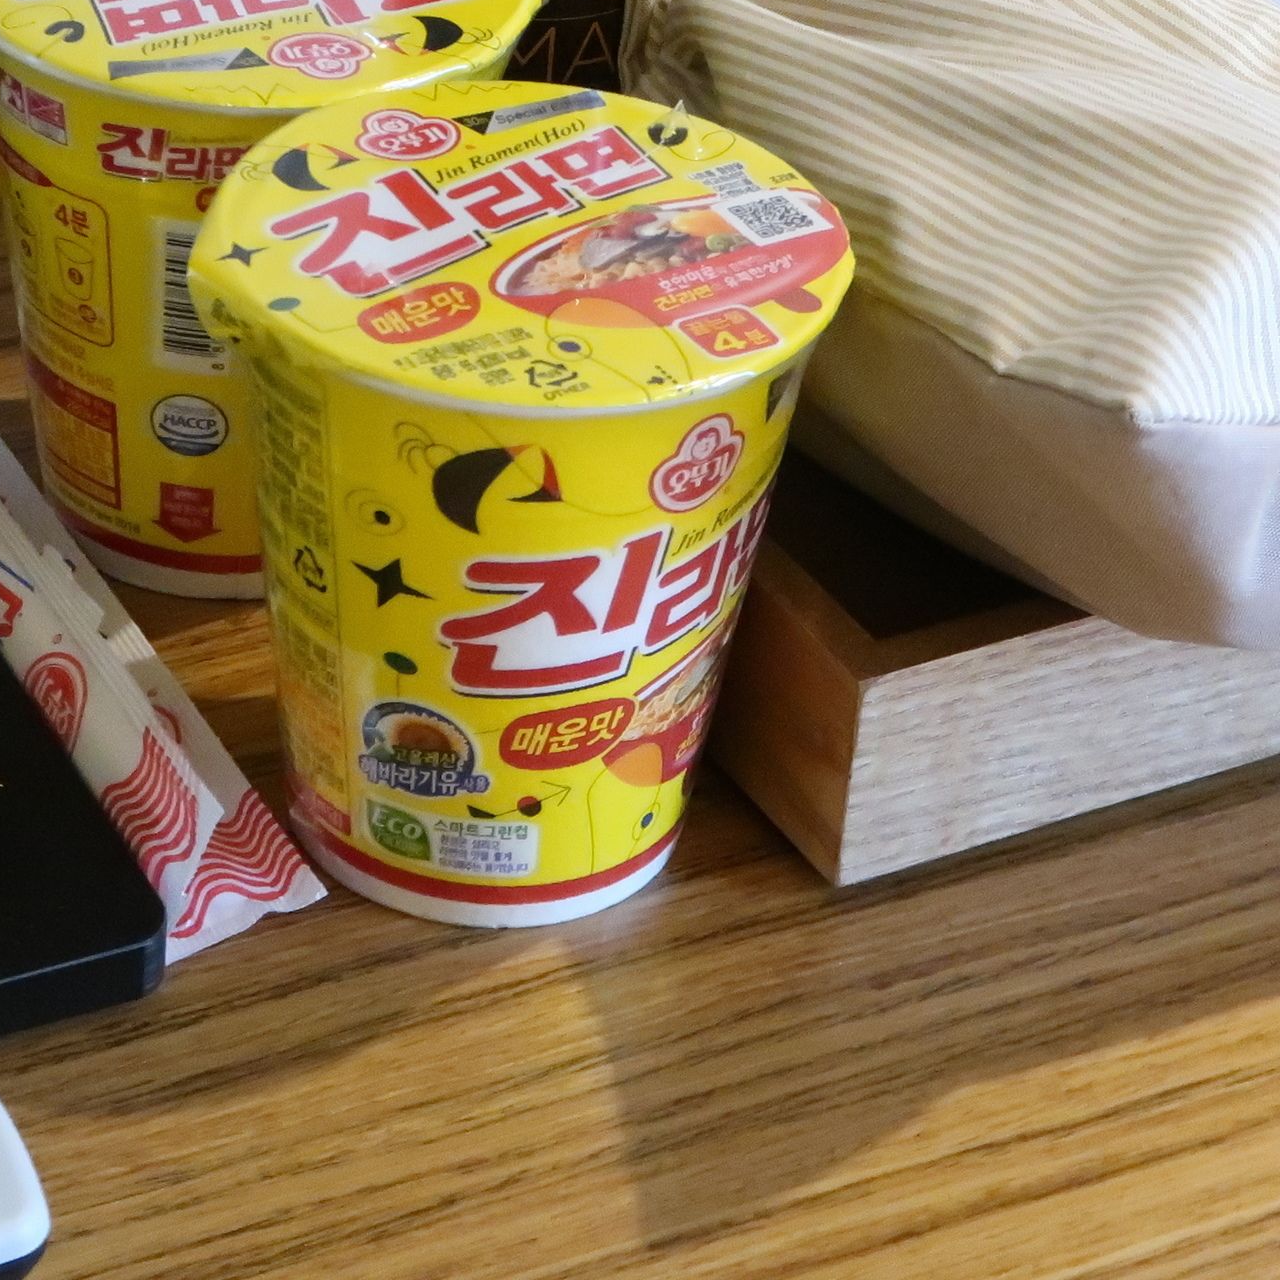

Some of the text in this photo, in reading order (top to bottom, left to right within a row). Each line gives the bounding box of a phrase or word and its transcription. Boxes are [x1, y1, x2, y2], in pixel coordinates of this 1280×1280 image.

[285, 9, 315, 26] Jin
[283, 41, 354, 64] 오뚜기
[494, 105, 548, 126] Special
[378, 128, 449, 154] 오뚜기
[434, 118, 587, 185] Jin Ramen(Hot)
[269, 124, 673, 298] 진라면
[658, 263, 727, 293] 호안미로
[369, 285, 474, 339] 매운맛
[653, 283, 722, 313] 진라면
[163, 412, 218, 431] HACCP
[667, 454, 732, 498] 오뚜기
[672, 526, 708, 557] Jin
[509, 704, 625, 757] 매운맛
[360, 756, 460, 797] 해바라기유
[371, 807, 423, 839] ECO
[432, 819, 529, 841] 스마트그린컵
